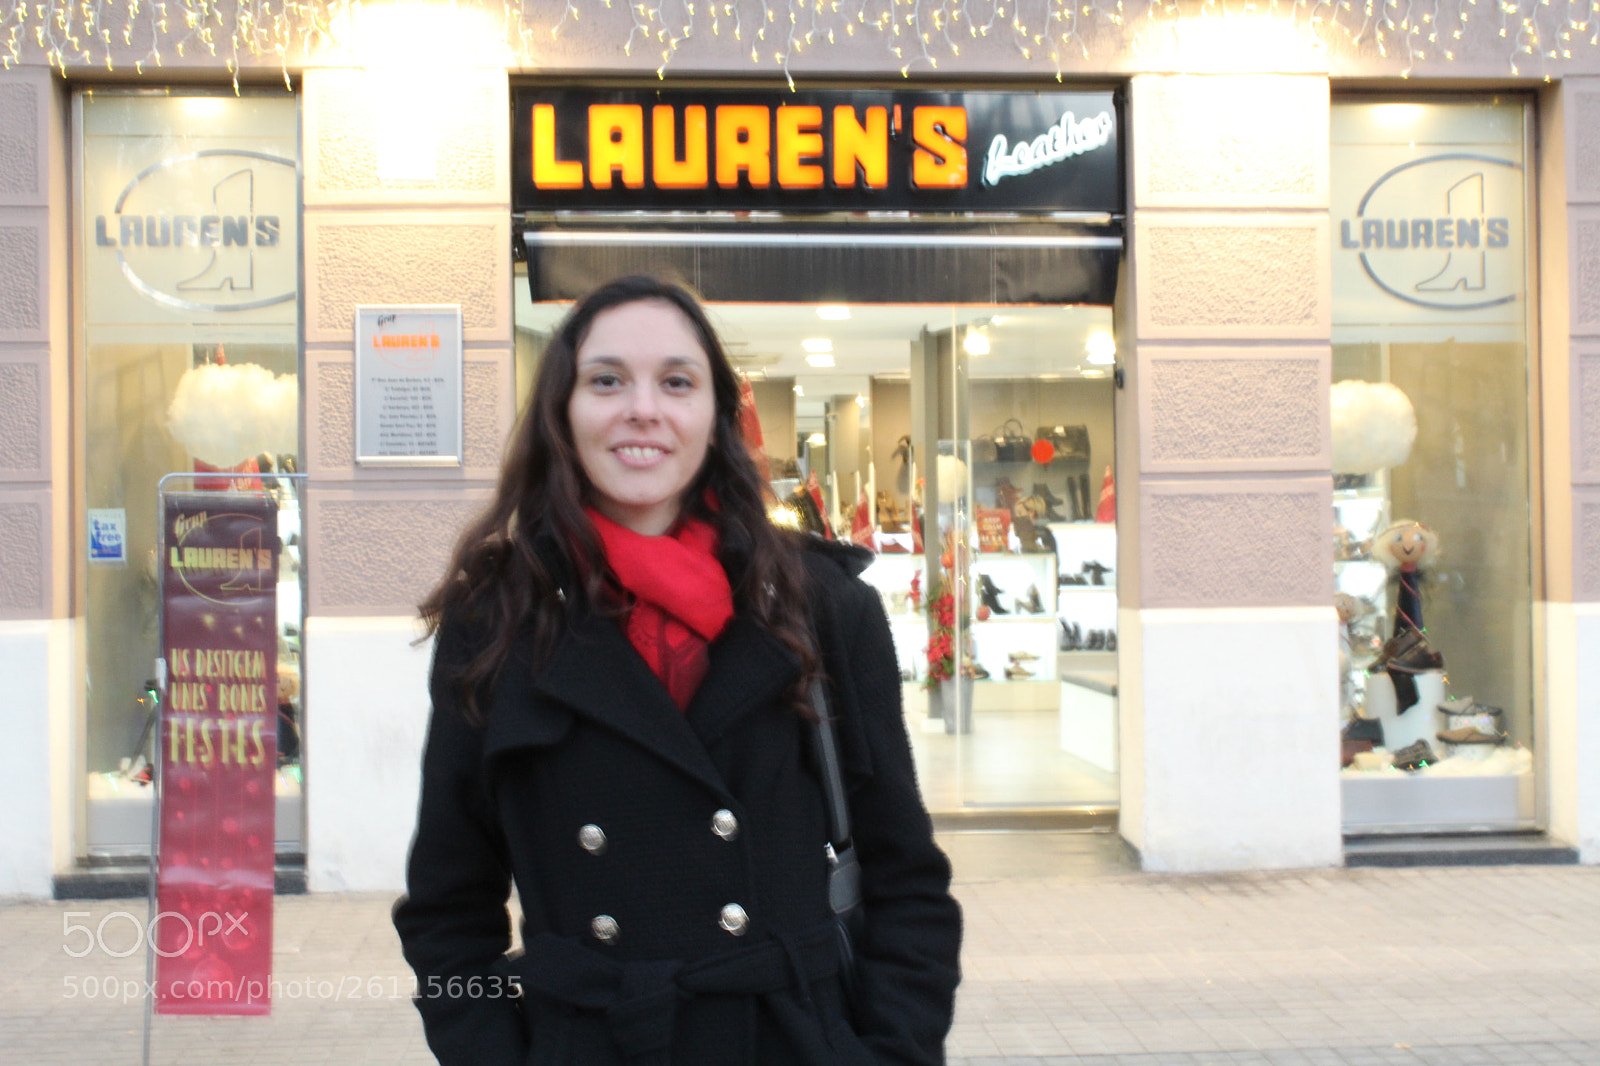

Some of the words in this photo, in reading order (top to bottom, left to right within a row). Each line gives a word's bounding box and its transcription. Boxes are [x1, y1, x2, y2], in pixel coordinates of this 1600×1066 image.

[532, 104, 968, 189] LAUREN'S
[95, 215, 280, 247] LAUREN'S
[1340, 218, 1509, 249] LAUREN'S
[94, 519, 116, 530] tax
[171, 547, 272, 569] LAUREN'S
[171, 648, 190, 677] US
[196, 648, 266, 678] DESITGEM
[171, 682, 208, 711] UNES
[219, 683, 266, 712] BONES
[170, 717, 265, 764] FESTES
